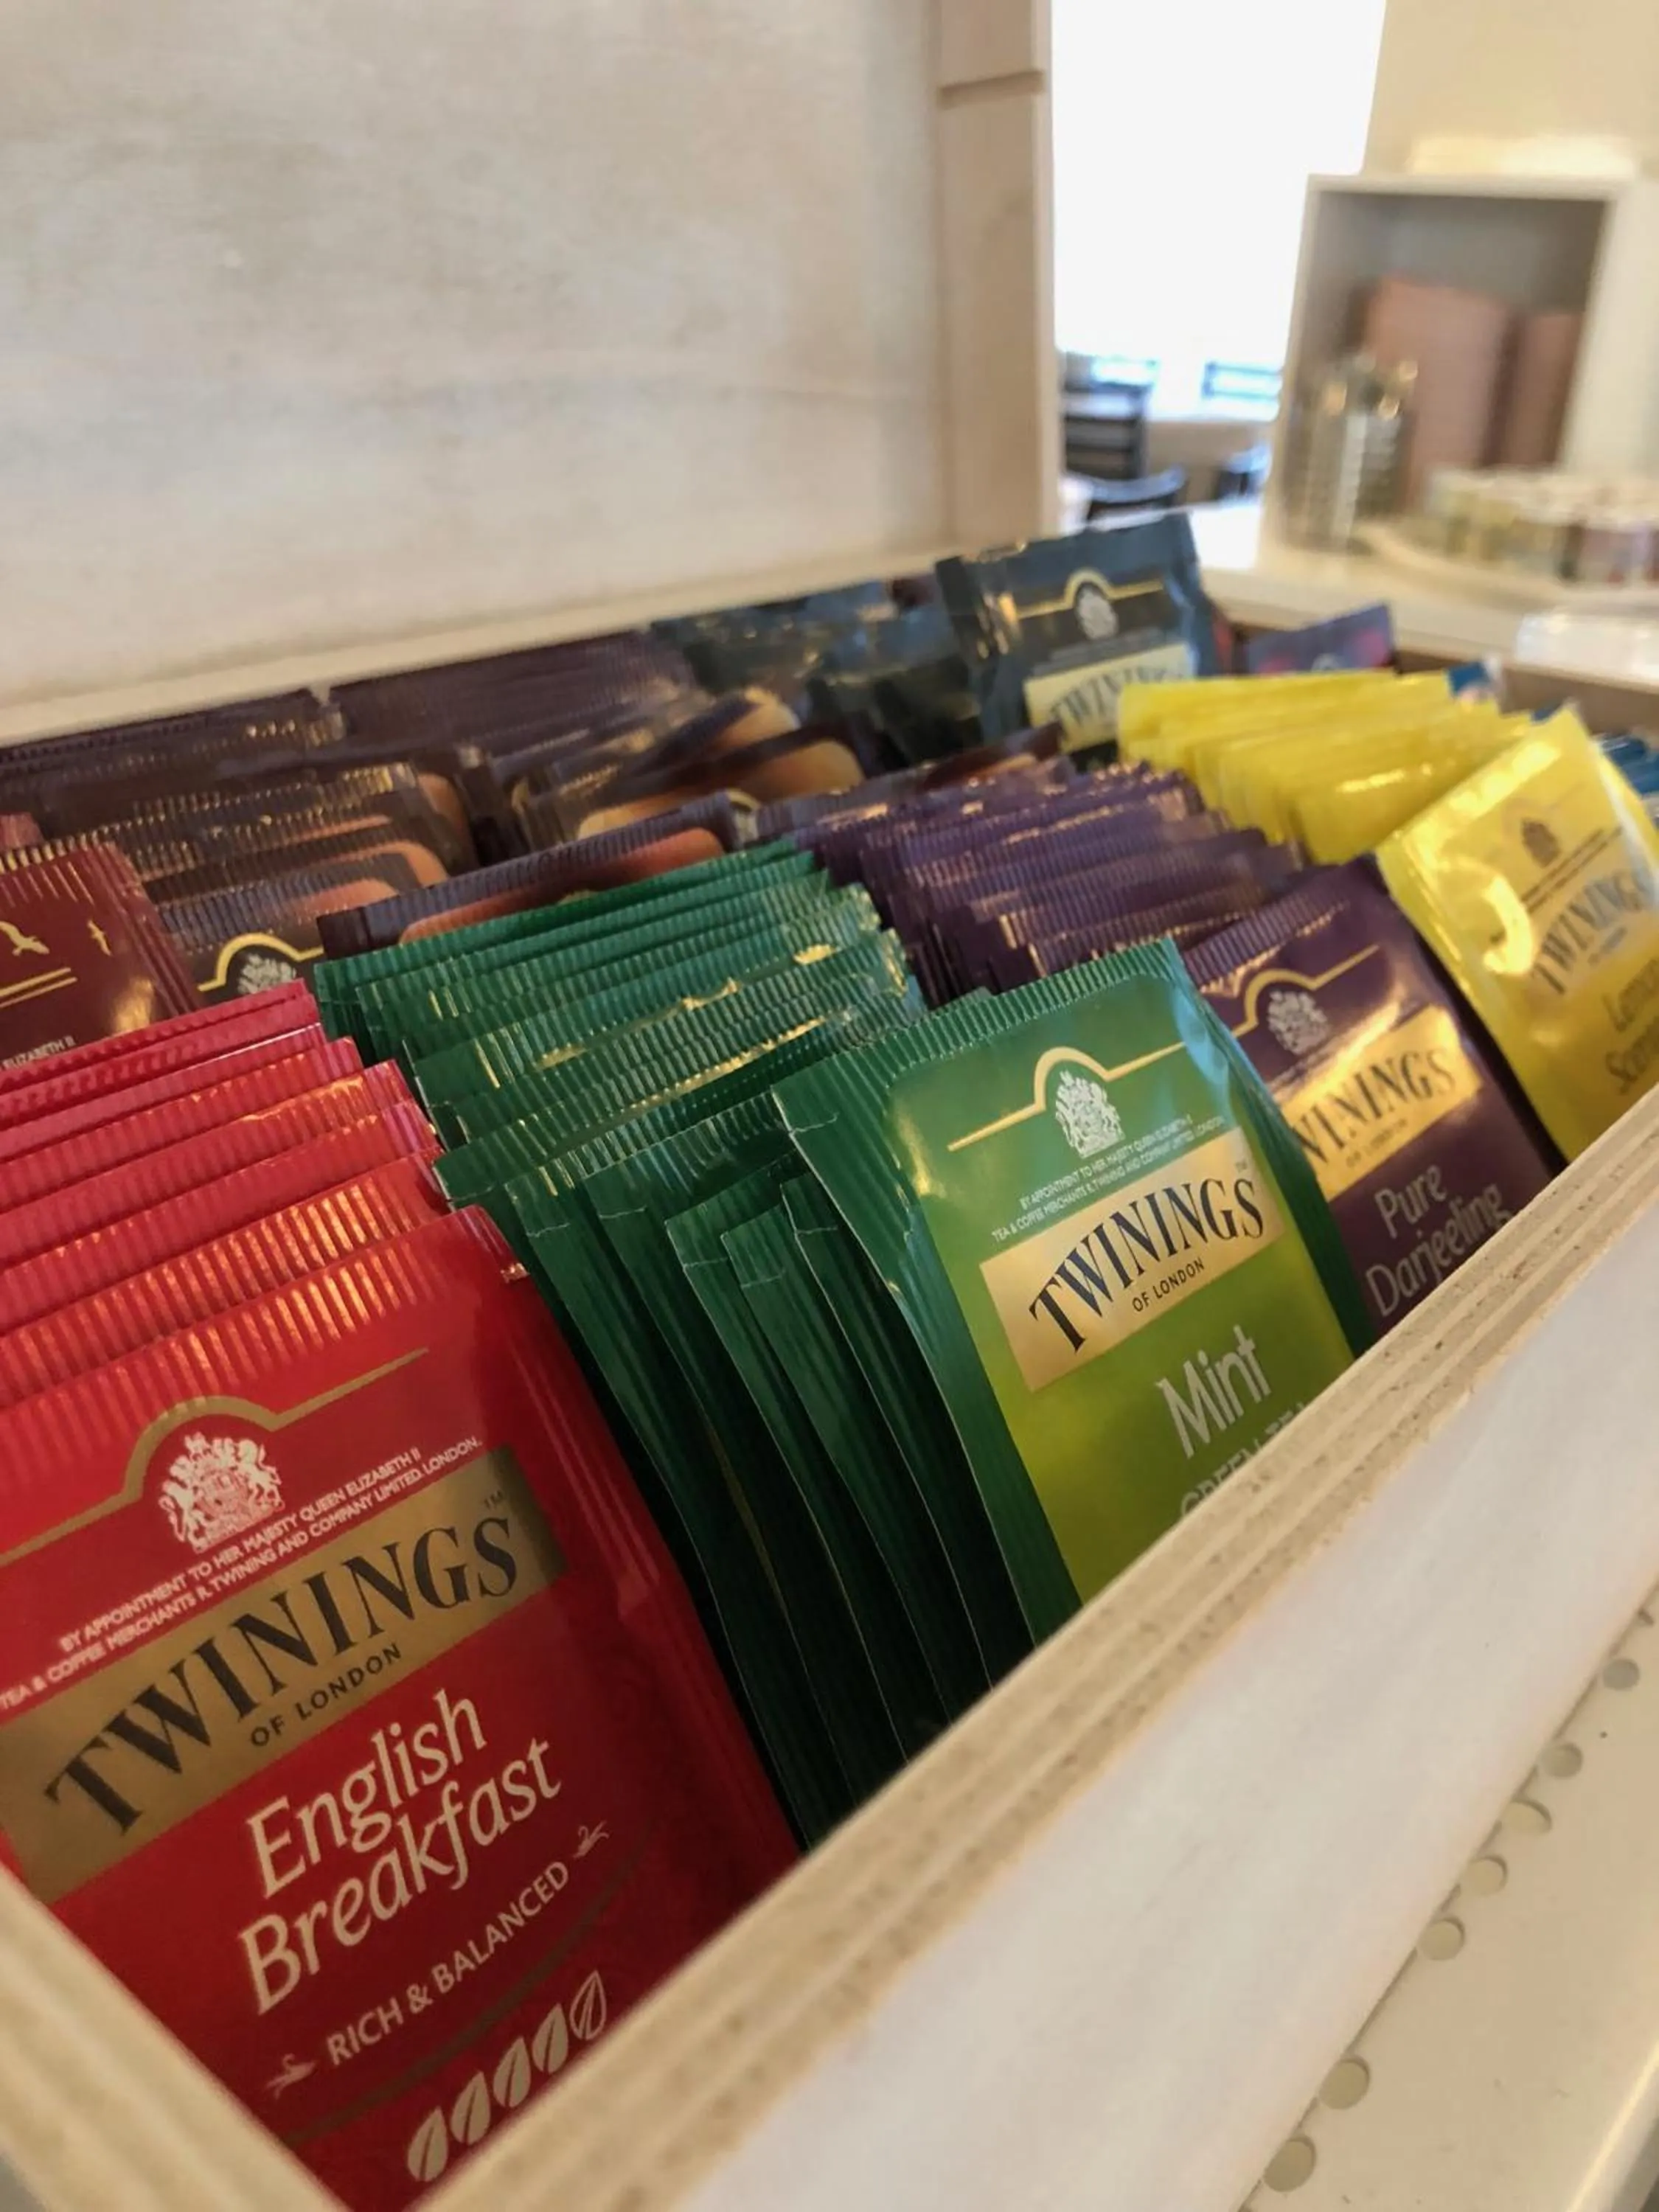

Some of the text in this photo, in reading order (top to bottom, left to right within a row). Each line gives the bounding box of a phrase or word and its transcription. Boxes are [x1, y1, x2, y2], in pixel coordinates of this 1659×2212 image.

[1029, 1178, 1266, 1354] TWININGS
[1131, 1256, 1206, 1314] OF LONDON
[1365, 1184, 1512, 1318] Darjeeling
[1374, 1164, 1448, 1239] Pure
[1155, 1325, 1272, 1459] Mint
[59, 1629, 83, 1652] BY
[83, 1573, 187, 1641] APPOINTMENT
[188, 1561, 212, 1582] TO
[212, 1545, 244, 1571] HER
[299, 1488, 347, 1522] QUEEN
[345, 1453, 413, 1497] ELIZABETH
[107, 1590, 198, 1652] MERCHANTS
[210, 1548, 277, 1591] TWINING
[277, 1530, 309, 1557] AND
[308, 1495, 374, 1537] COMPANY
[374, 1468, 422, 1503] LIMITED
[44, 1517, 518, 1836] TWININGS
[250, 1643, 404, 1747] OF LONDON
[239, 1738, 561, 2016] Breakfast
[246, 1688, 487, 1900] English
[325, 1861, 569, 2065] RICH & BALANCED
